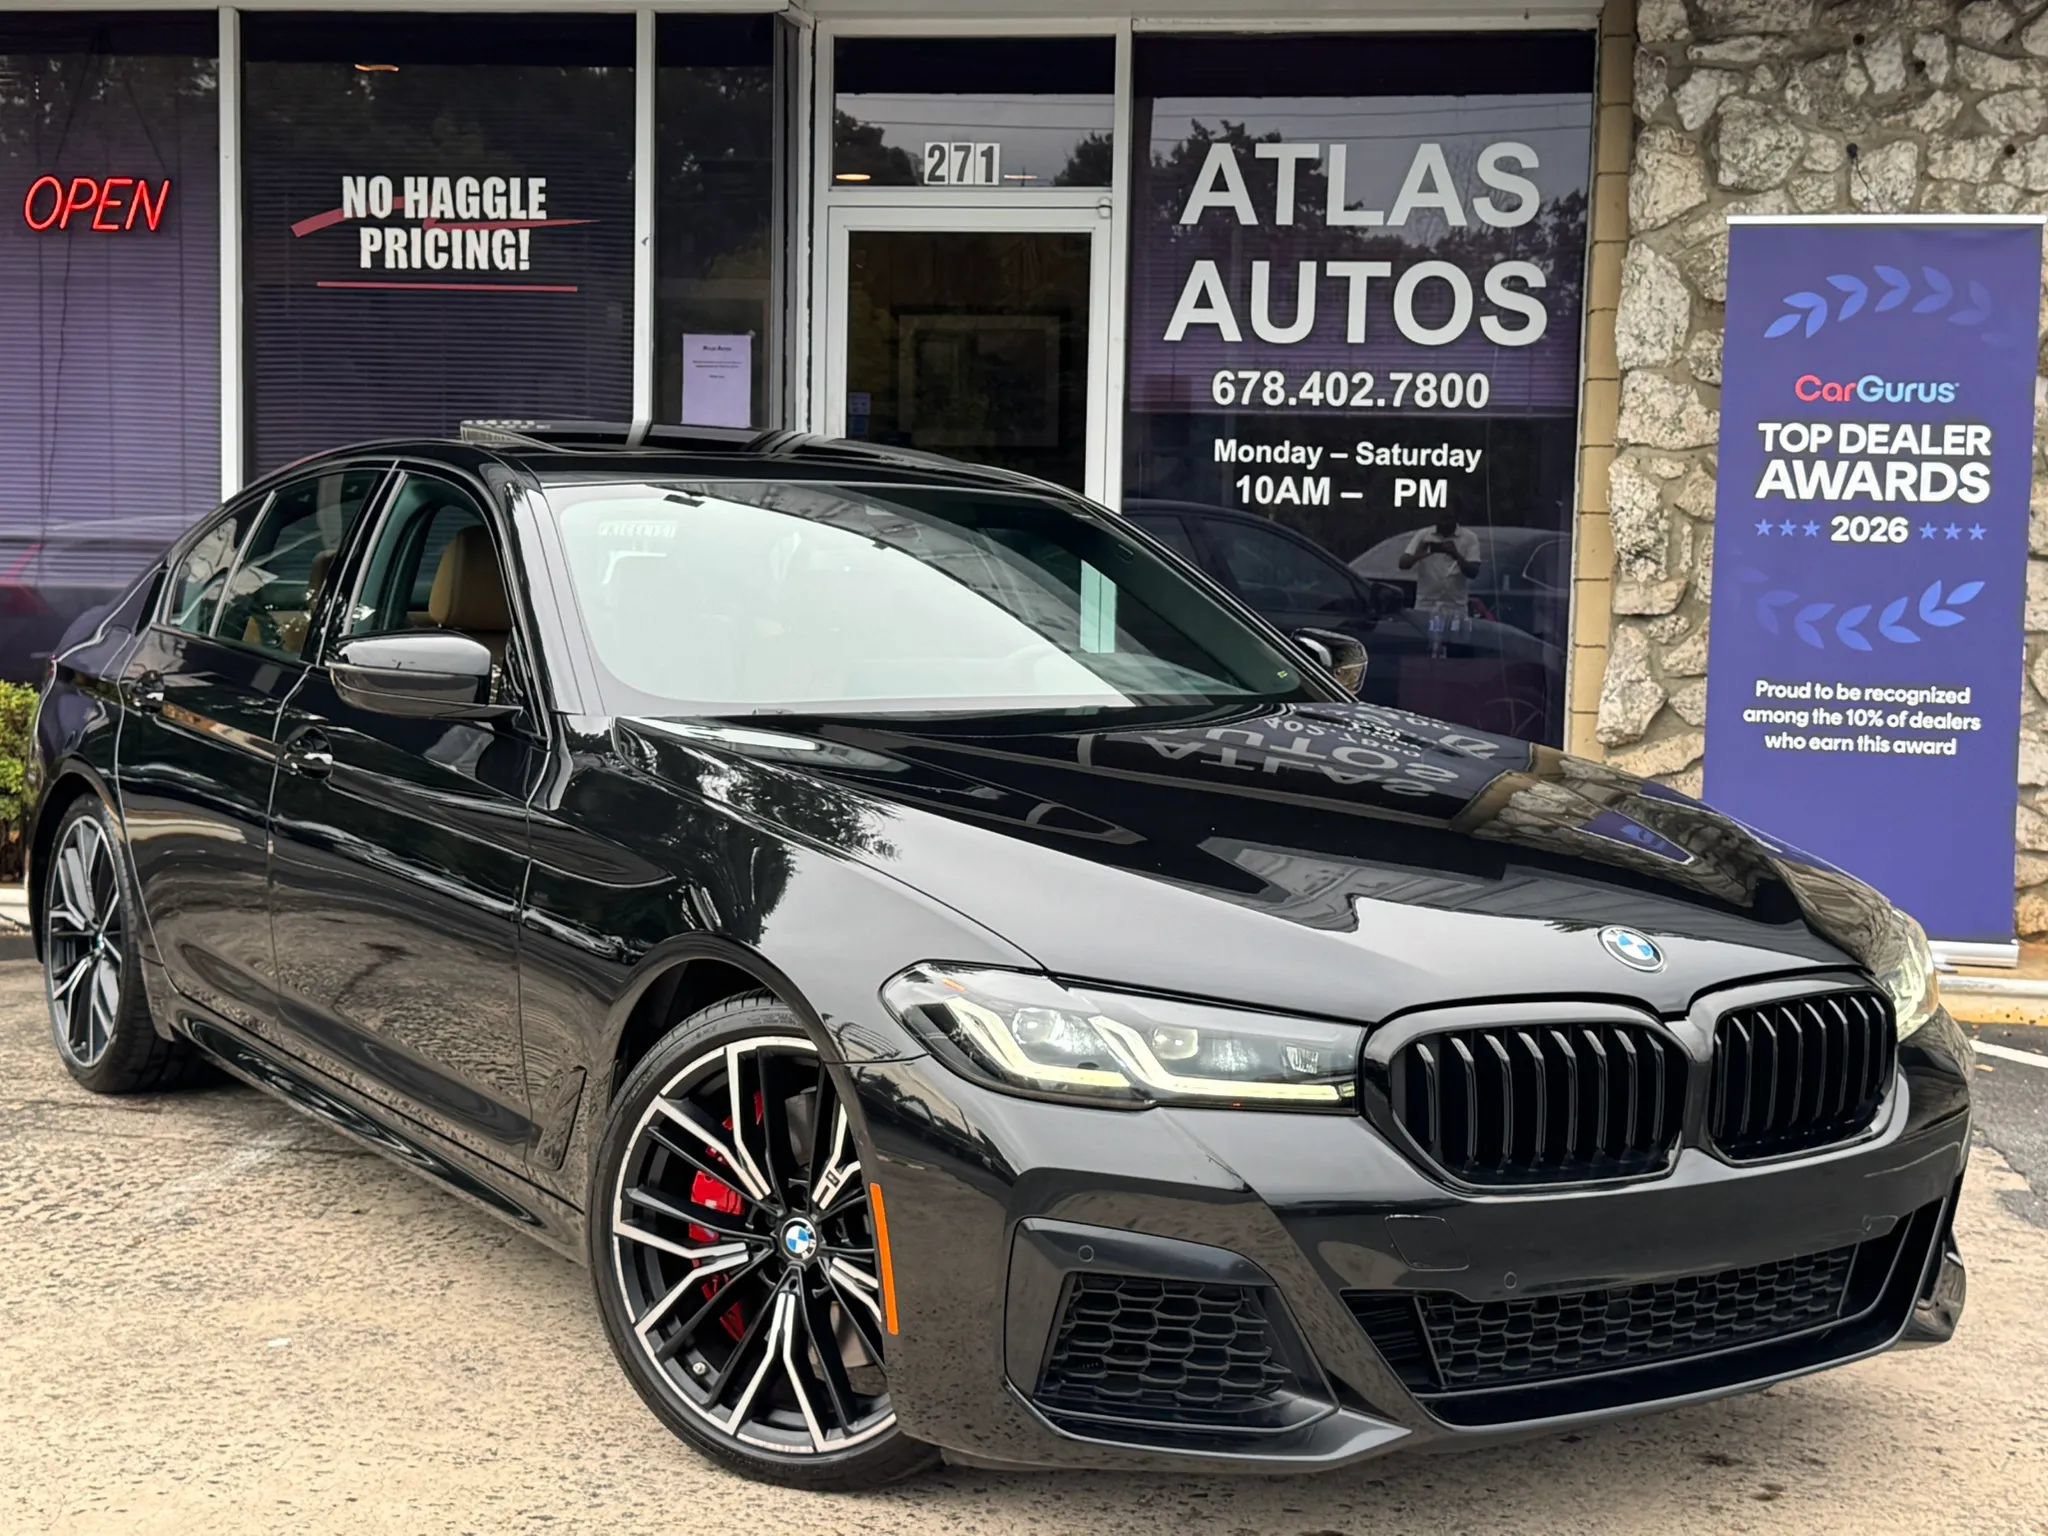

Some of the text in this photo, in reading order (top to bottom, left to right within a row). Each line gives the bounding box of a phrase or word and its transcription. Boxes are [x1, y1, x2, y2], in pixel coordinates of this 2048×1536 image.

[927, 143, 994, 183] 271
[24, 175, 171, 231] OPEN
[342, 175, 547, 220] NO HAGGLE
[1178, 141, 1540, 228] ATLAS
[359, 226, 530, 271] PRICING!
[1162, 259, 1548, 347] AUTOS
[1211, 370, 1490, 409] 678.402.7800
[1794, 374, 1957, 403] CarGurus
[1213, 438, 1324, 470] Monday
[1355, 441, 1483, 473] Saturday
[1757, 422, 1992, 456] TOP DEALER
[1236, 475, 1331, 506] 10AM
[1393, 478, 1449, 508] PM
[1754, 458, 1991, 504] AWARDS
[1830, 515, 1910, 543] 2026
[1755, 680, 1972, 706] Proud to be recognized
[1742, 707, 1982, 731] among the 10% of dealers
[1764, 732, 1958, 756] who earn this award
